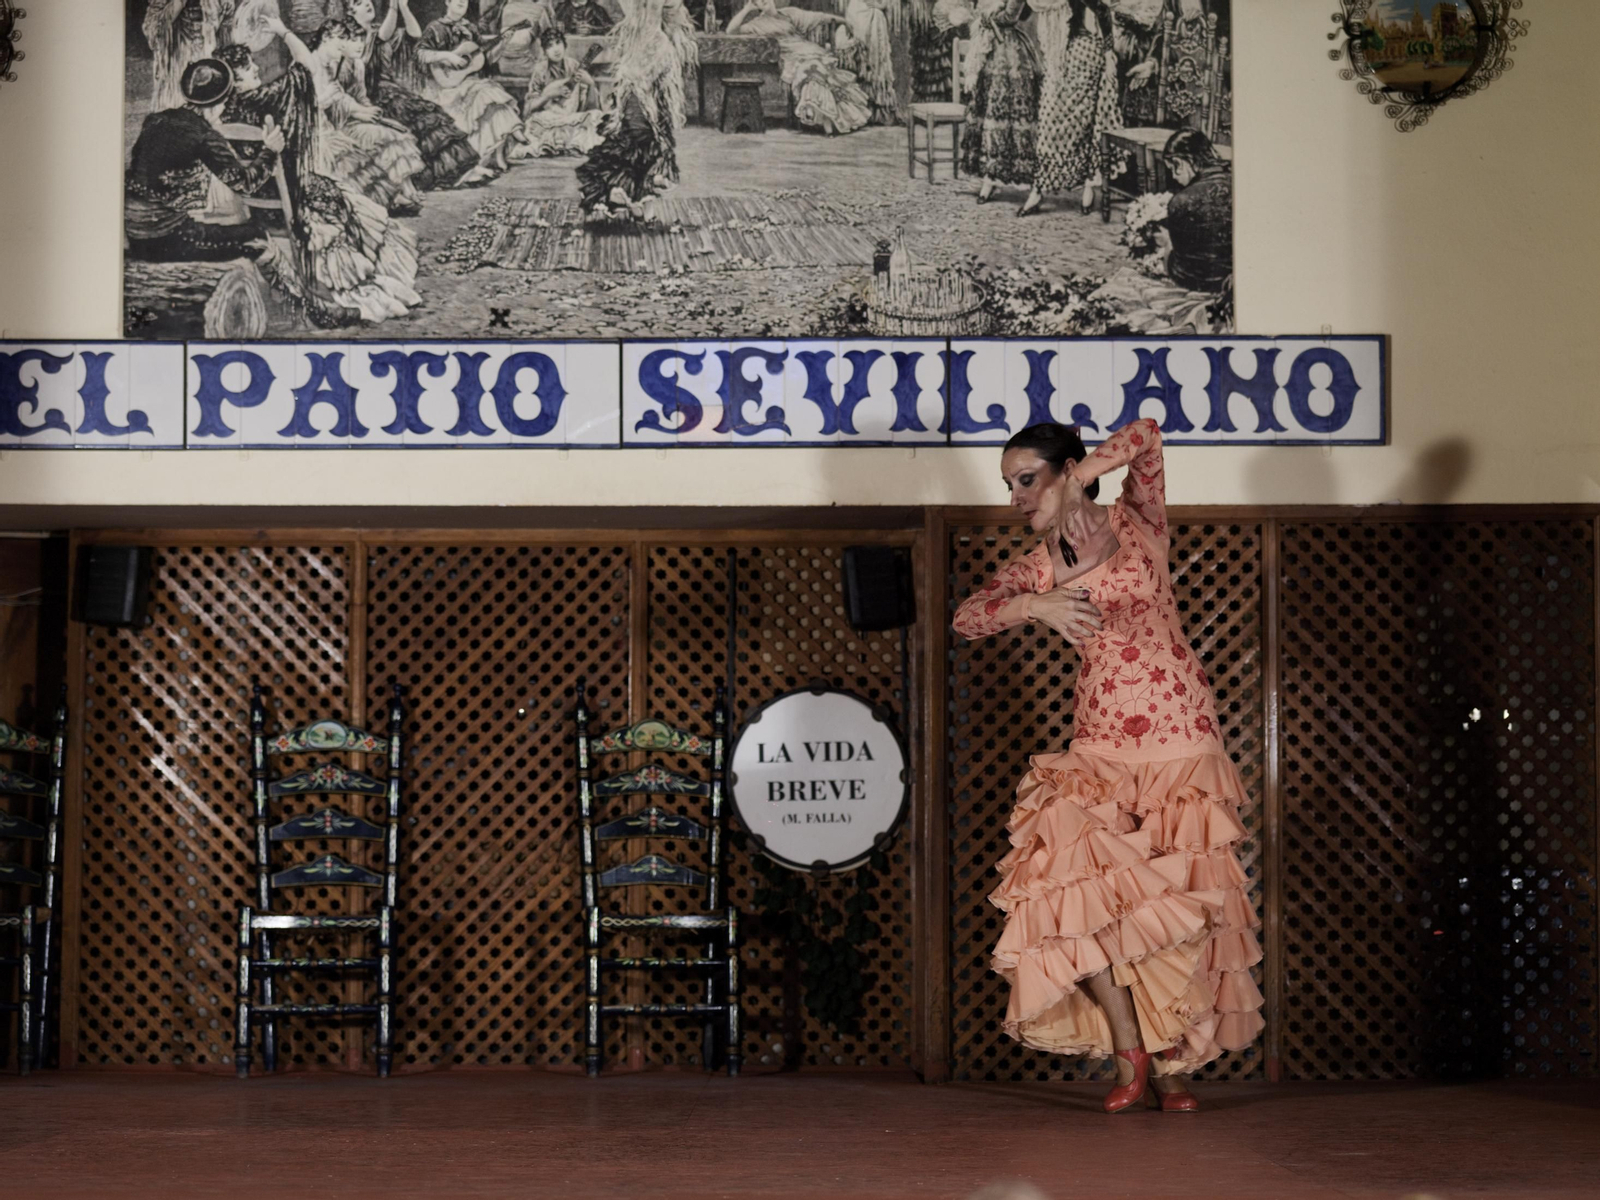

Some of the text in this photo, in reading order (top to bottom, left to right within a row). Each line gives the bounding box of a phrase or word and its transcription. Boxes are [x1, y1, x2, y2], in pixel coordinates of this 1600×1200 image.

[0, 346, 1362, 438] EL PATIO SEVILLANO
[757, 740, 875, 764] LA VIDA
[767, 779, 867, 802] BREVE
[782, 812, 852, 826] (M. FALLA)
